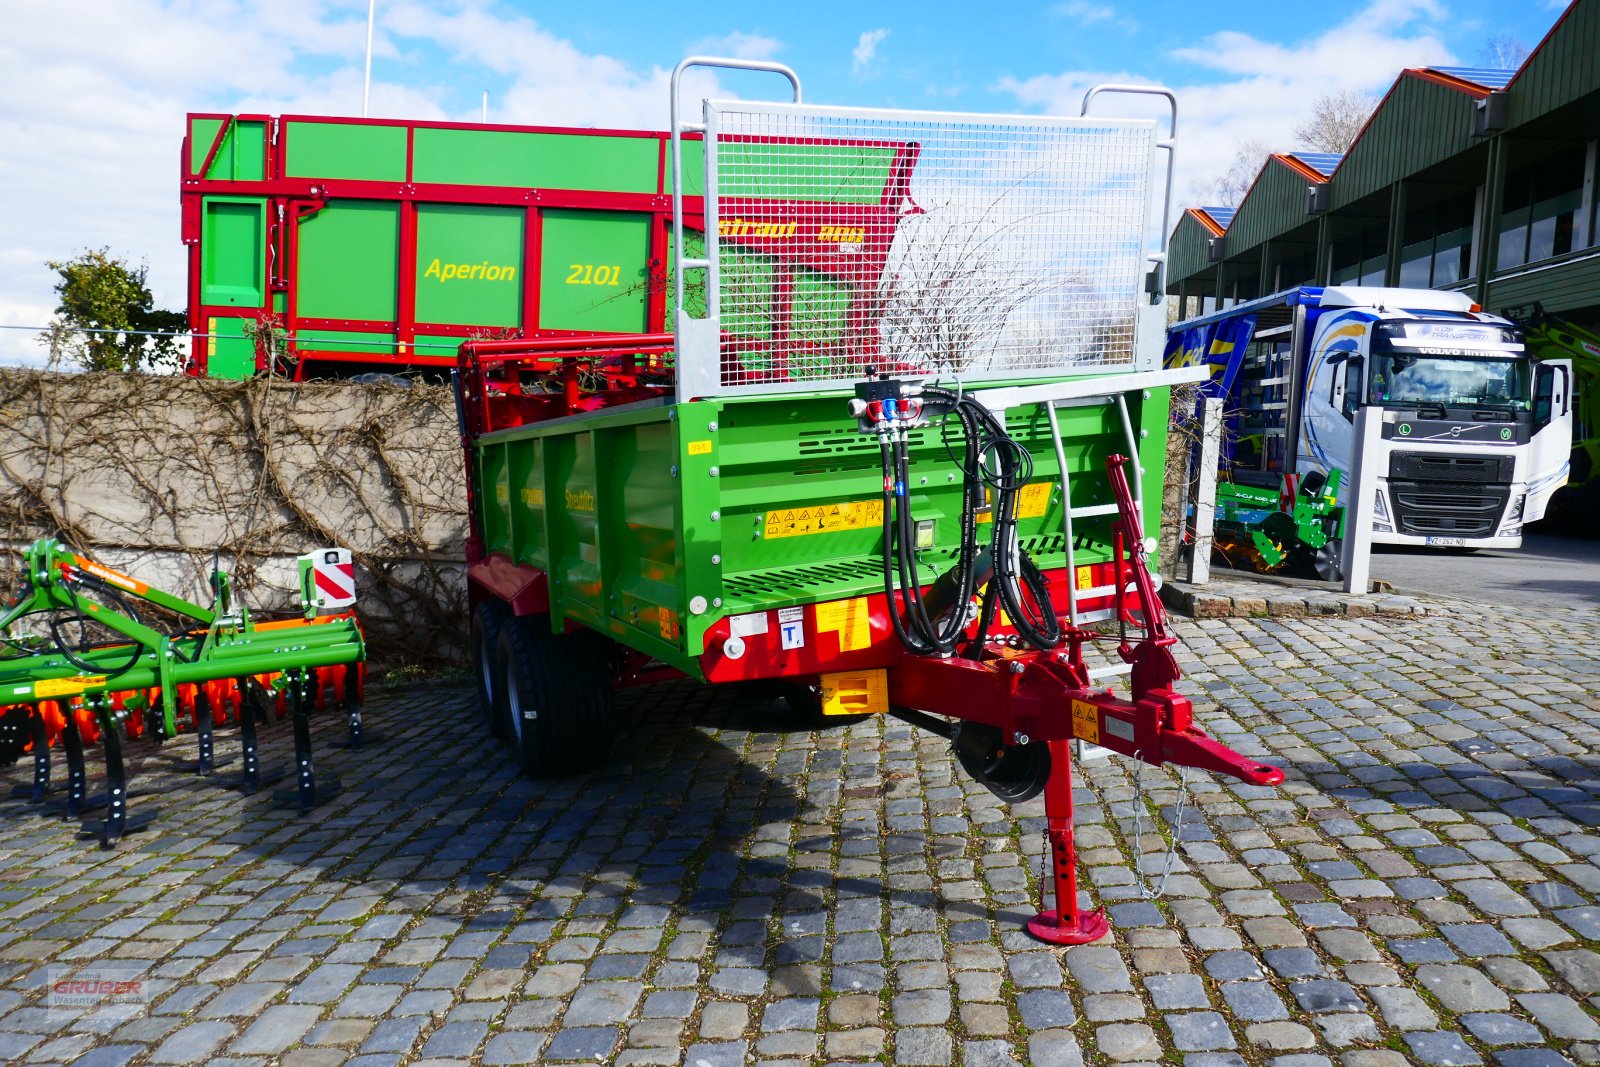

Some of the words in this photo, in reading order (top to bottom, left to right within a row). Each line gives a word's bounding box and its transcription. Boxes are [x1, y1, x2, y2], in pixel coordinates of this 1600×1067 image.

[424, 258, 515, 282] Aperion
[565, 264, 621, 285] 2101
[1419, 347, 1460, 356] VOLVO
[783, 626, 796, 641] T
